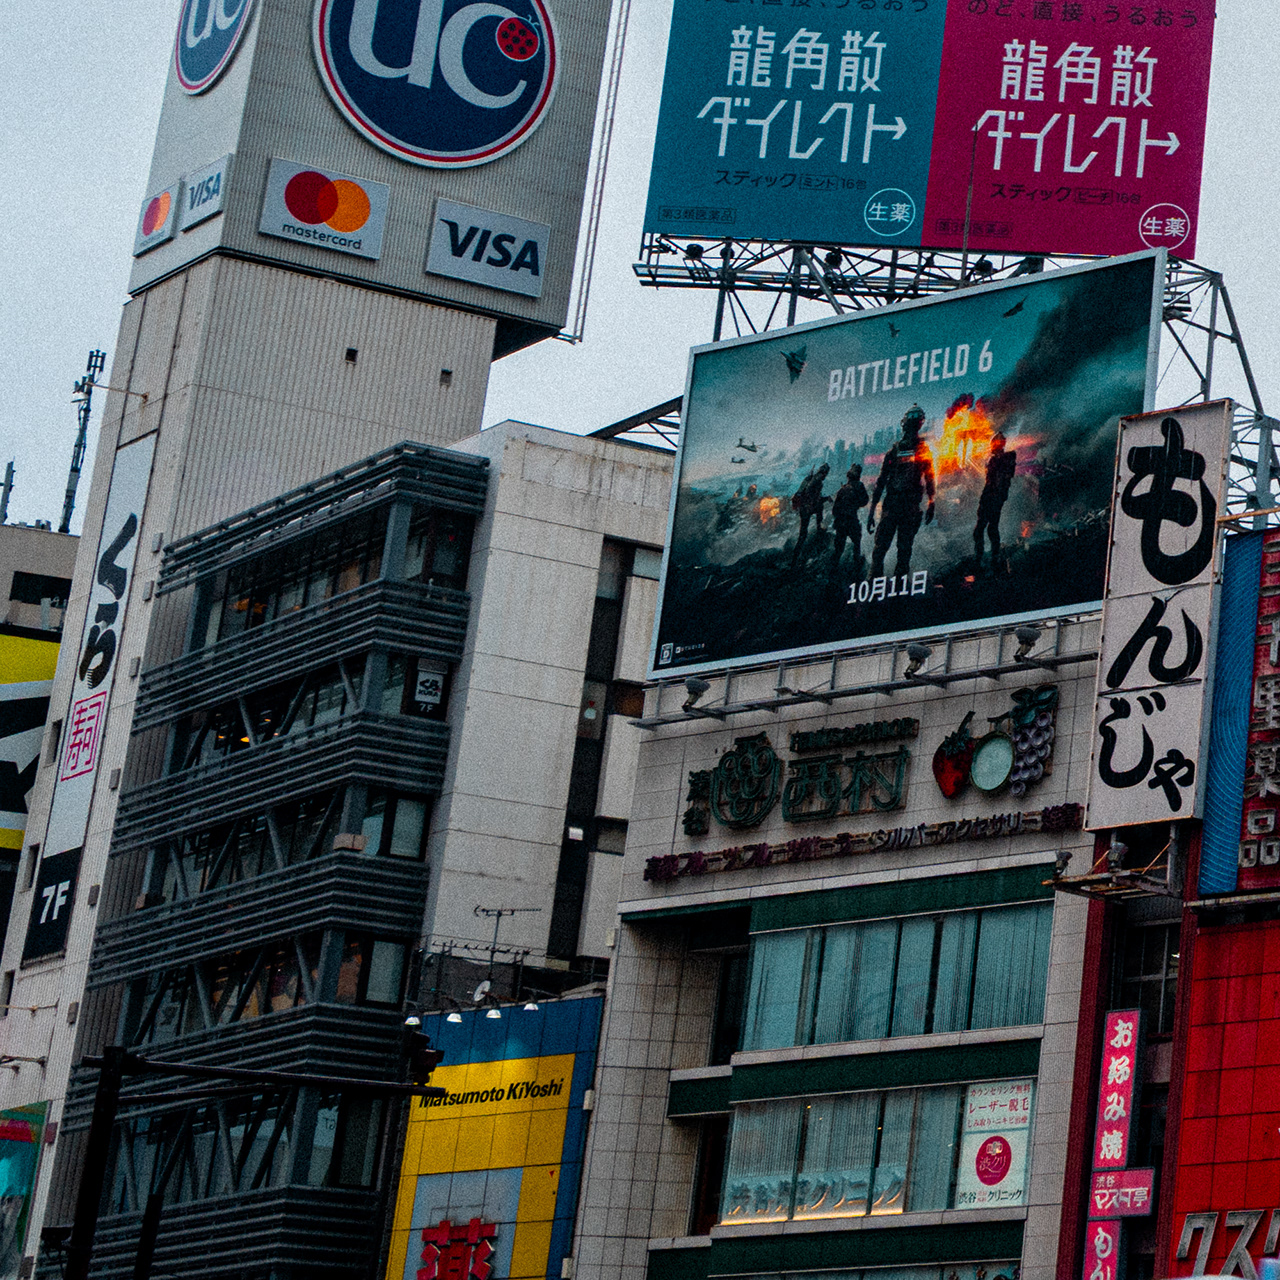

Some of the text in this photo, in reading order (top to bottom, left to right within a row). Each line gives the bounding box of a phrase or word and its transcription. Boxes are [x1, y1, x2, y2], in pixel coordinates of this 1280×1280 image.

[727, 24, 887, 94] 龍角散
[1000, 38, 1158, 108] 龍角散
[696, 95, 908, 164] ダイレクト
[971, 109, 1181, 179] ダイレクト
[188, 172, 222, 210] VISA
[714, 169, 797, 188] スティック
[990, 183, 1072, 202] スティック
[867, 202, 912, 222] 生薬
[1142, 216, 1187, 238] 生薬
[281, 221, 363, 251] mastercard
[440, 218, 540, 277] VISA
[827, 339, 994, 403] BATTLEFIELD 6
[846, 570, 929, 605] 10月11日
[1097, 416, 1218, 812] もんじゃ
[40, 879, 71, 925] 7F
[419, 1077, 564, 1108] Matsumoto KiYoshi
[968, 1096, 1030, 1114] レーザー脱毛
[1099, 1018, 1134, 1161] お好み焼
[958, 1191, 977, 1204] 渋谷
[986, 1189, 1023, 1203] クリニック
[1096, 1175, 1116, 1188] 渋谷
